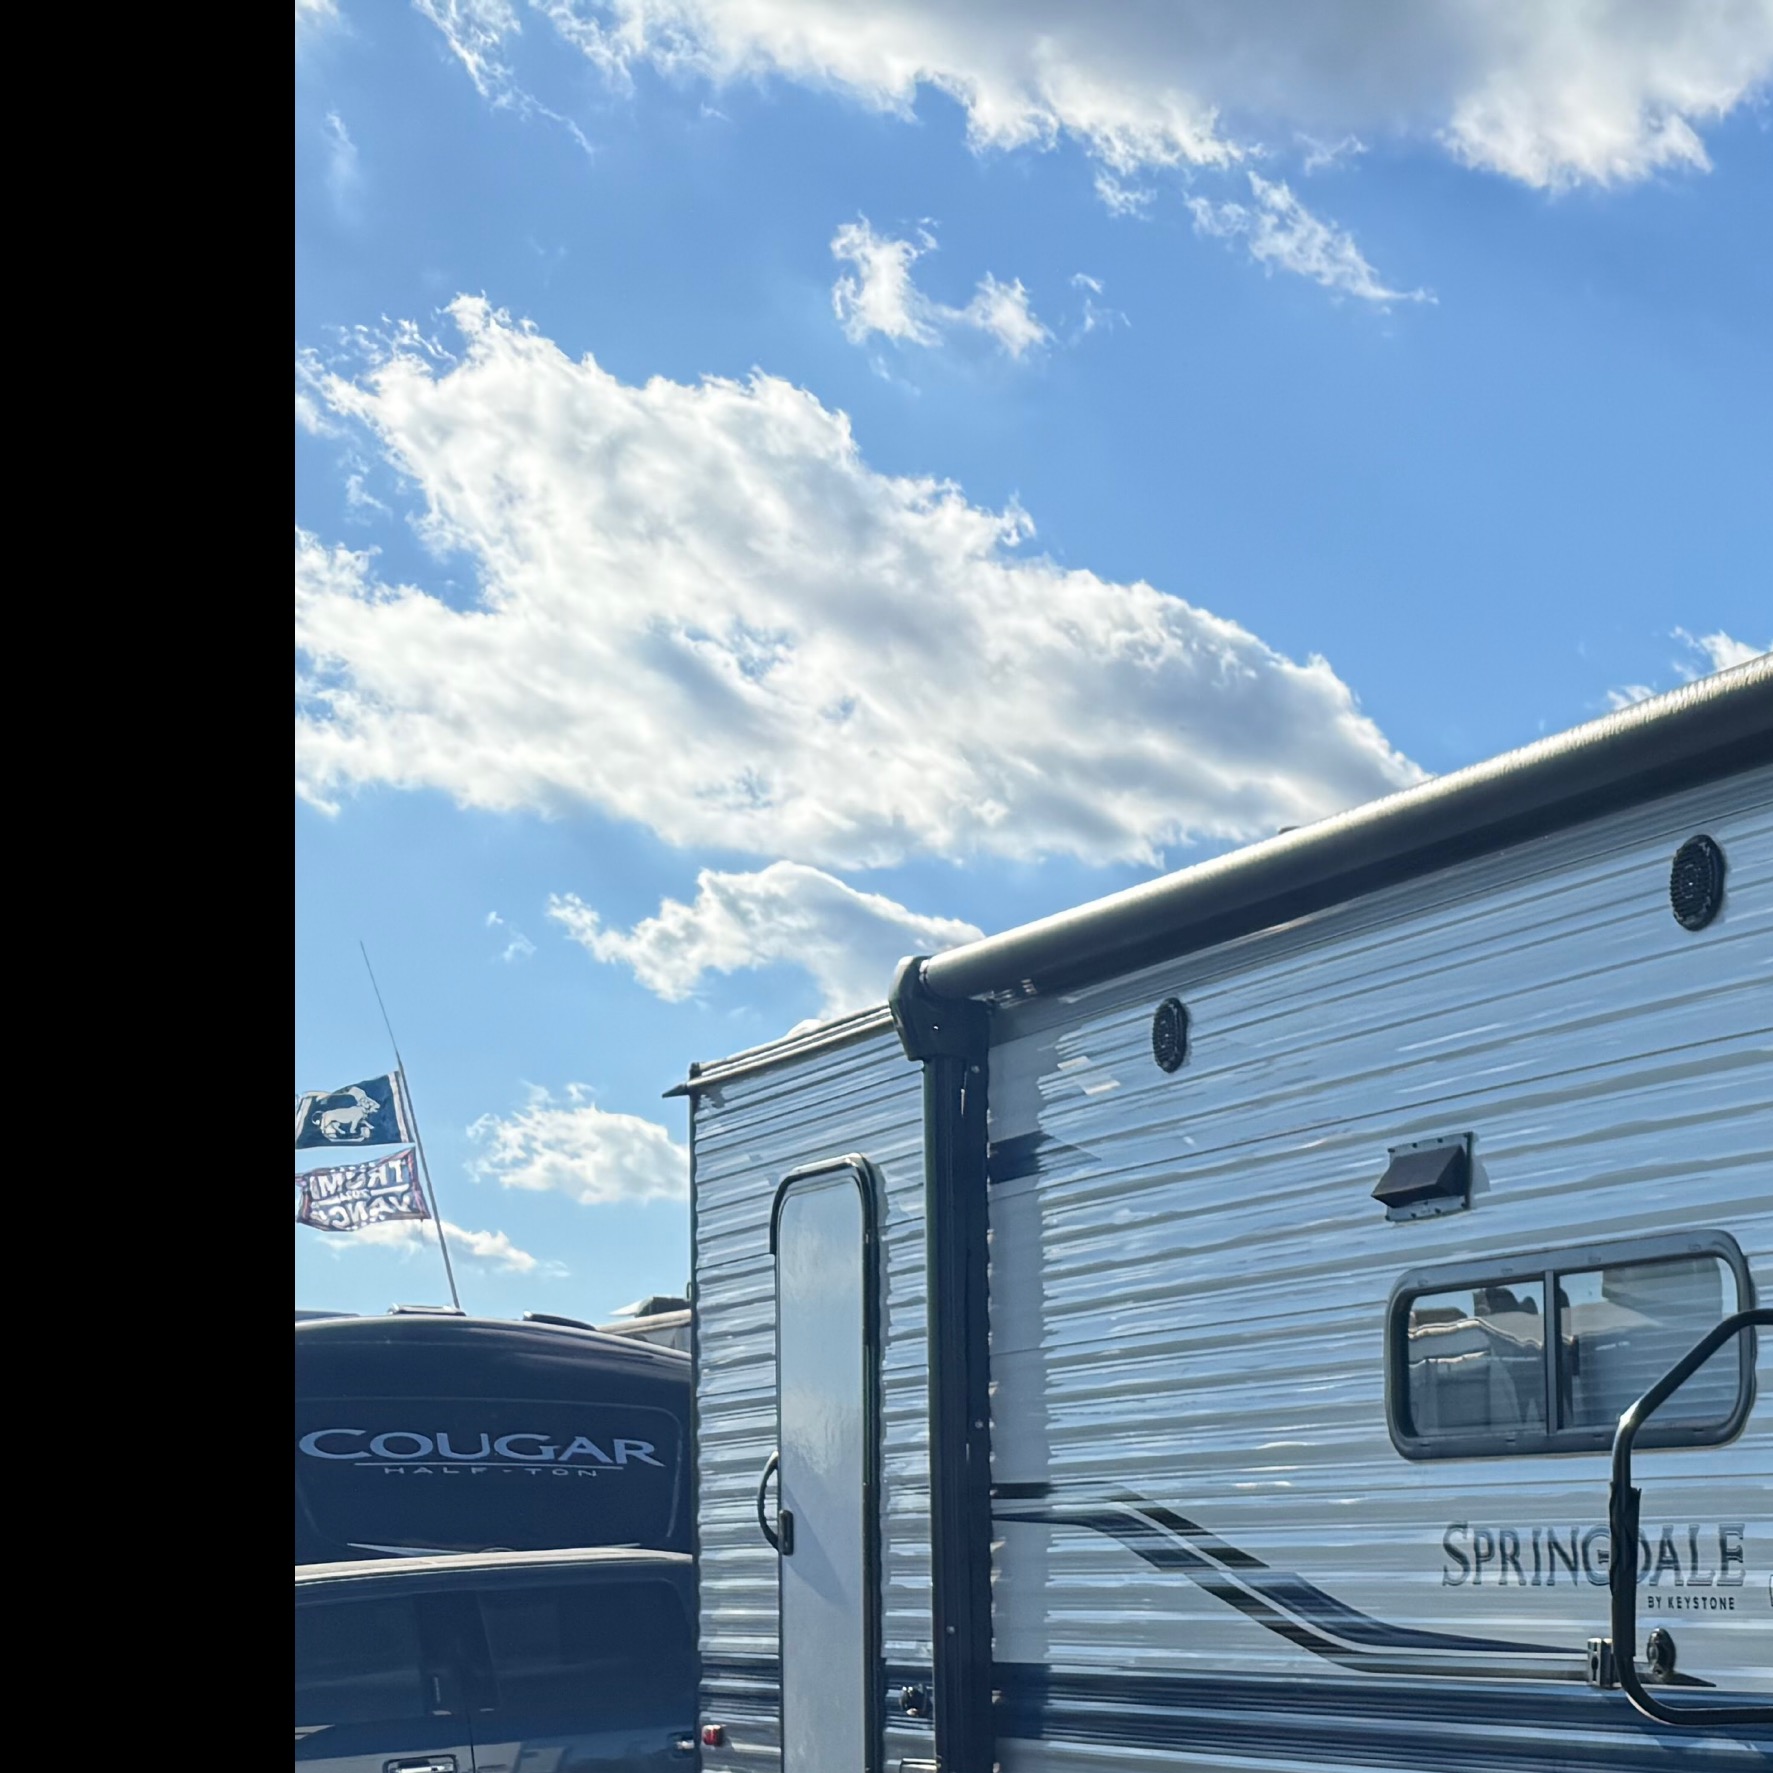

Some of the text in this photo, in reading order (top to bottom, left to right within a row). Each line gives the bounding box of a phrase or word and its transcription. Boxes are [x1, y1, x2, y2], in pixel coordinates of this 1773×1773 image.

[300, 1428, 665, 1467] COUGAR
[384, 1466, 597, 1477] HALF-TON
[1648, 1596, 1735, 1610] BY KEYSTONE
